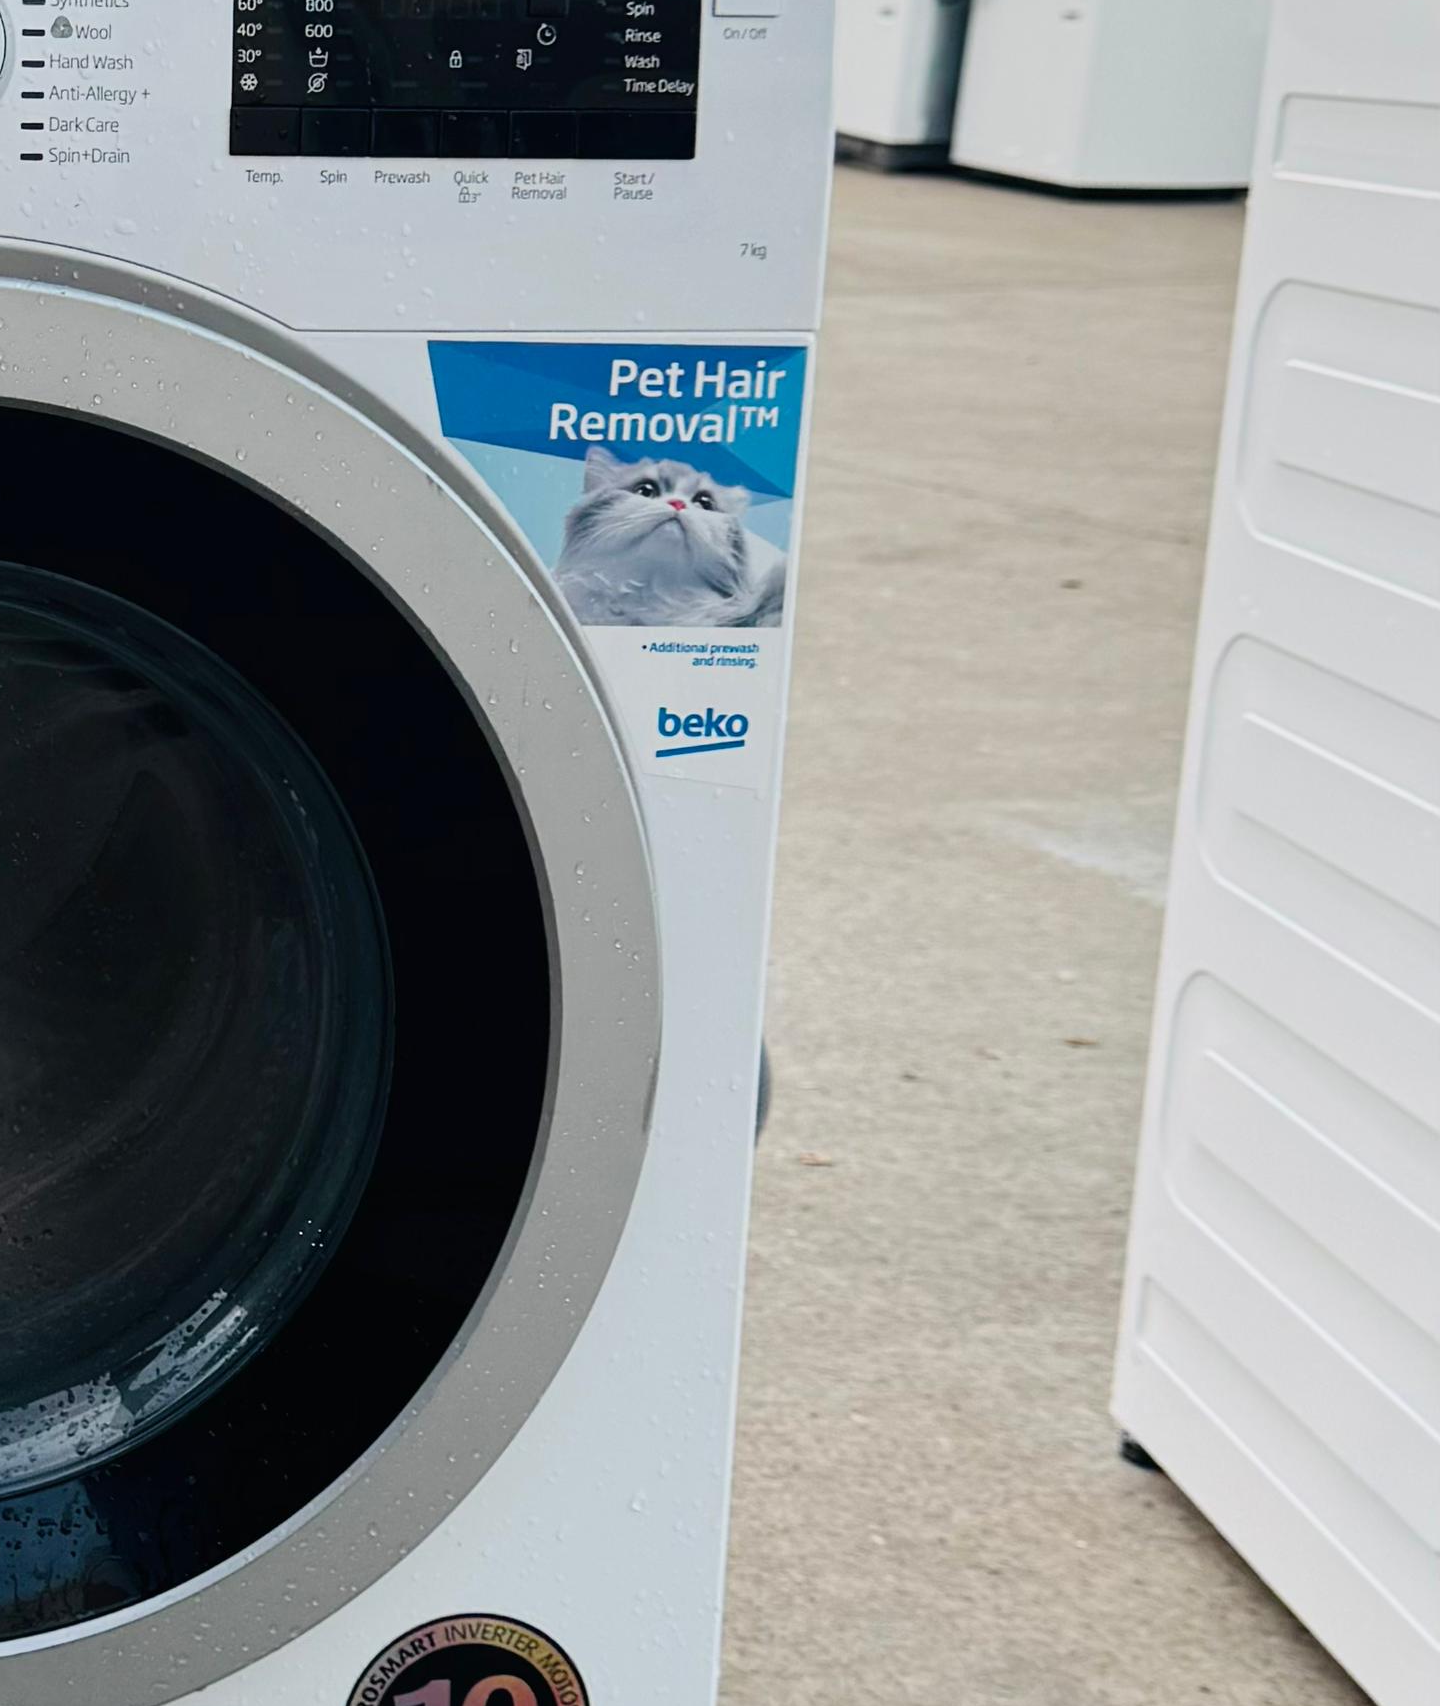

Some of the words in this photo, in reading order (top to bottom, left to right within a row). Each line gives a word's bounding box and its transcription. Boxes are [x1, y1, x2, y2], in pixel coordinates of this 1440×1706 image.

[626, 2, 655, 18] Spin
[76, 24, 112, 40] Wool
[305, 24, 333, 38] 600
[625, 29, 661, 43] Rinse
[50, 54, 84, 70] Hand
[87, 54, 133, 71] Wash
[625, 55, 660, 68] Wash
[50, 85, 138, 105] Anti-Allergy
[624, 79, 657, 93] Time
[658, 79, 694, 97] Delay
[50, 117, 80, 133] Dark
[82, 118, 119, 133] Care
[49, 148, 130, 168] Spin+Drain
[246, 170, 283, 185] Temp.
[320, 170, 347, 186] Spin
[375, 170, 430, 184] Prewash
[454, 170, 489, 186] Quick
[514, 171, 537, 184] Pet
[539, 172, 566, 185] Hair
[512, 187, 567, 200] Removal
[613, 187, 653, 201] Pause
[609, 358, 683, 399] Pet
[694, 360, 786, 400] Hair
[649, 642, 708, 653] Additional
[692, 656, 714, 666] and
[658, 707, 749, 738] beko
[445, 1621, 540, 1657] INVERTER
